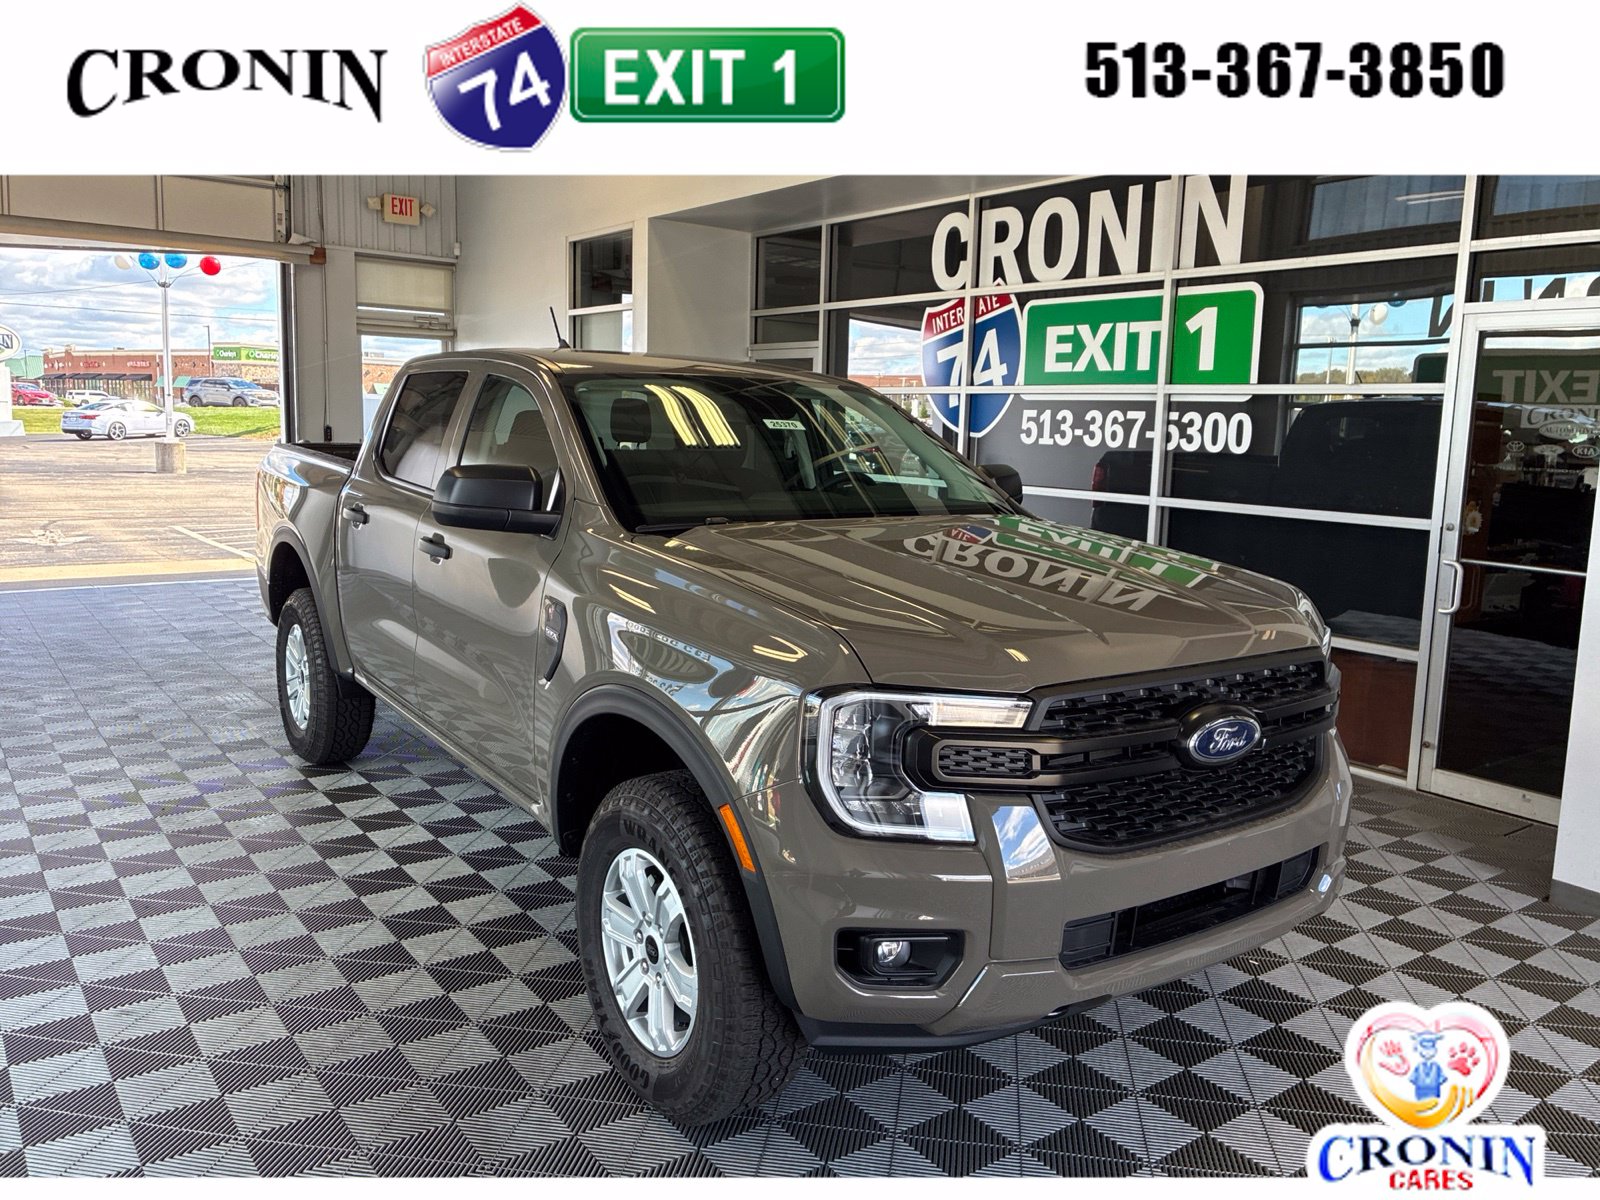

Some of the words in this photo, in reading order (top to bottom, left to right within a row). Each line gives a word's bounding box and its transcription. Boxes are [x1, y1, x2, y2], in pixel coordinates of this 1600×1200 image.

[391, 196, 415, 217] EXIT
[931, 175, 1249, 290] CRONIN
[932, 295, 1001, 334] INTERATE
[1044, 320, 1164, 373] EXIT
[1185, 306, 1218, 371] 1
[937, 328, 1008, 408] 74
[1020, 409, 1253, 455] 513-367-5300
[1576, 447, 1595, 456] KIA
[1209, 725, 1248, 754] Ford
